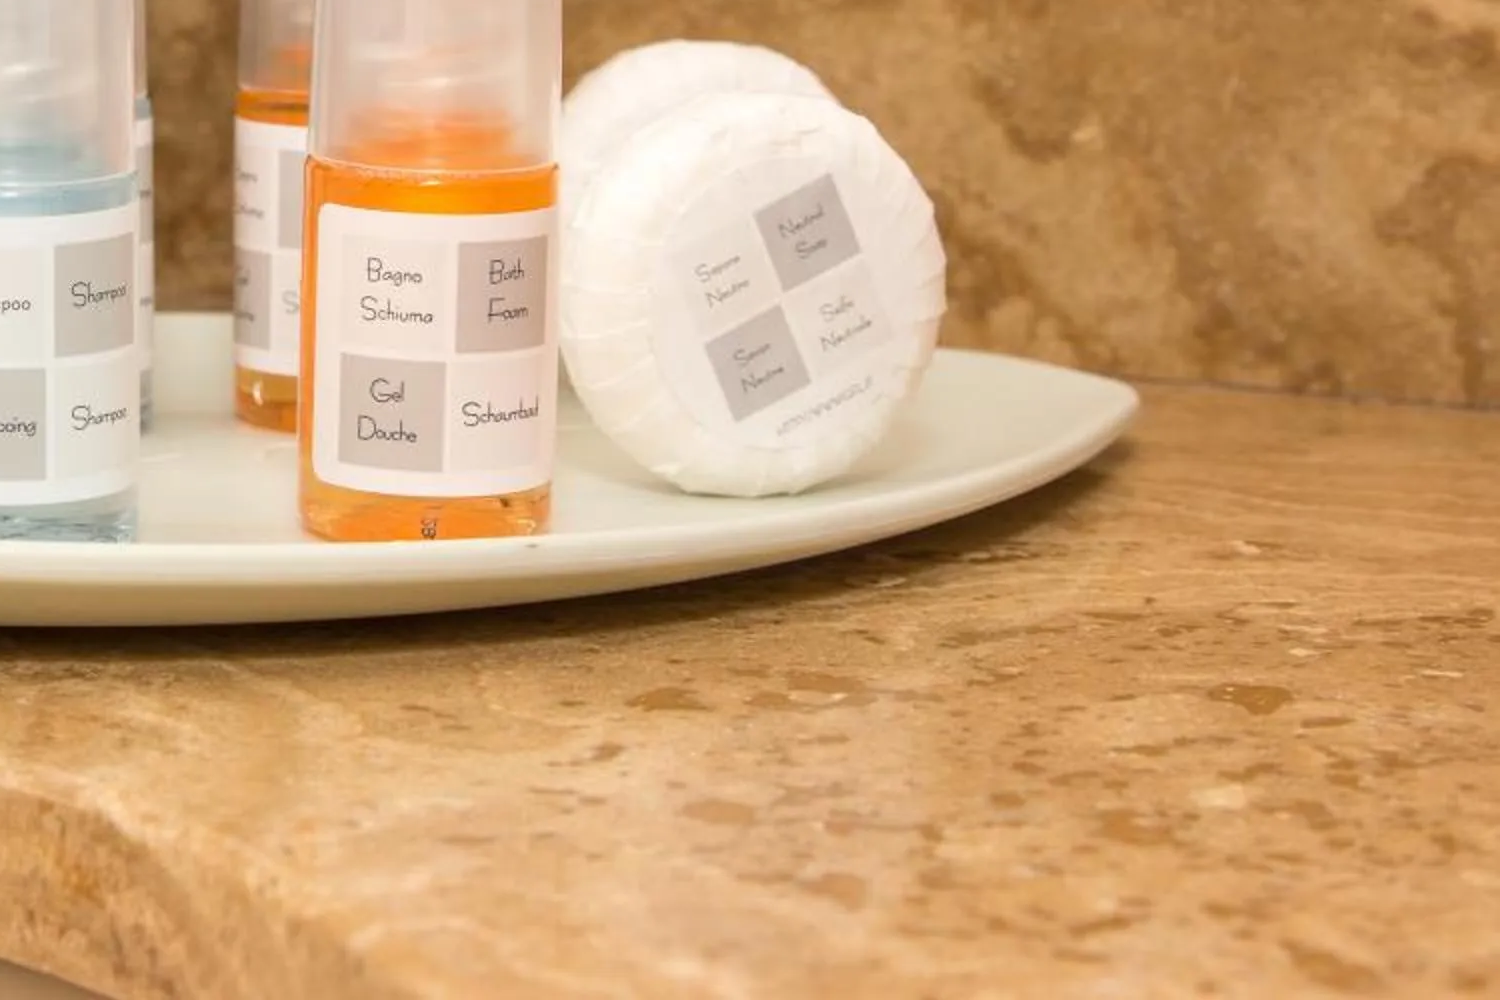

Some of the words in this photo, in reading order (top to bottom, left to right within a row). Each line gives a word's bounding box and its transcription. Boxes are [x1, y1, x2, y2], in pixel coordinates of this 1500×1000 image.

[367, 257, 422, 285] Bagno
[488, 258, 525, 285] Bath
[71, 280, 127, 308] Shampoo
[360, 296, 433, 323] Schiuma
[487, 298, 529, 323] Foam
[369, 378, 405, 403] Gel
[71, 405, 128, 431] Shampoo
[462, 395, 539, 427] Schaumbad
[357, 416, 418, 443] Douche
